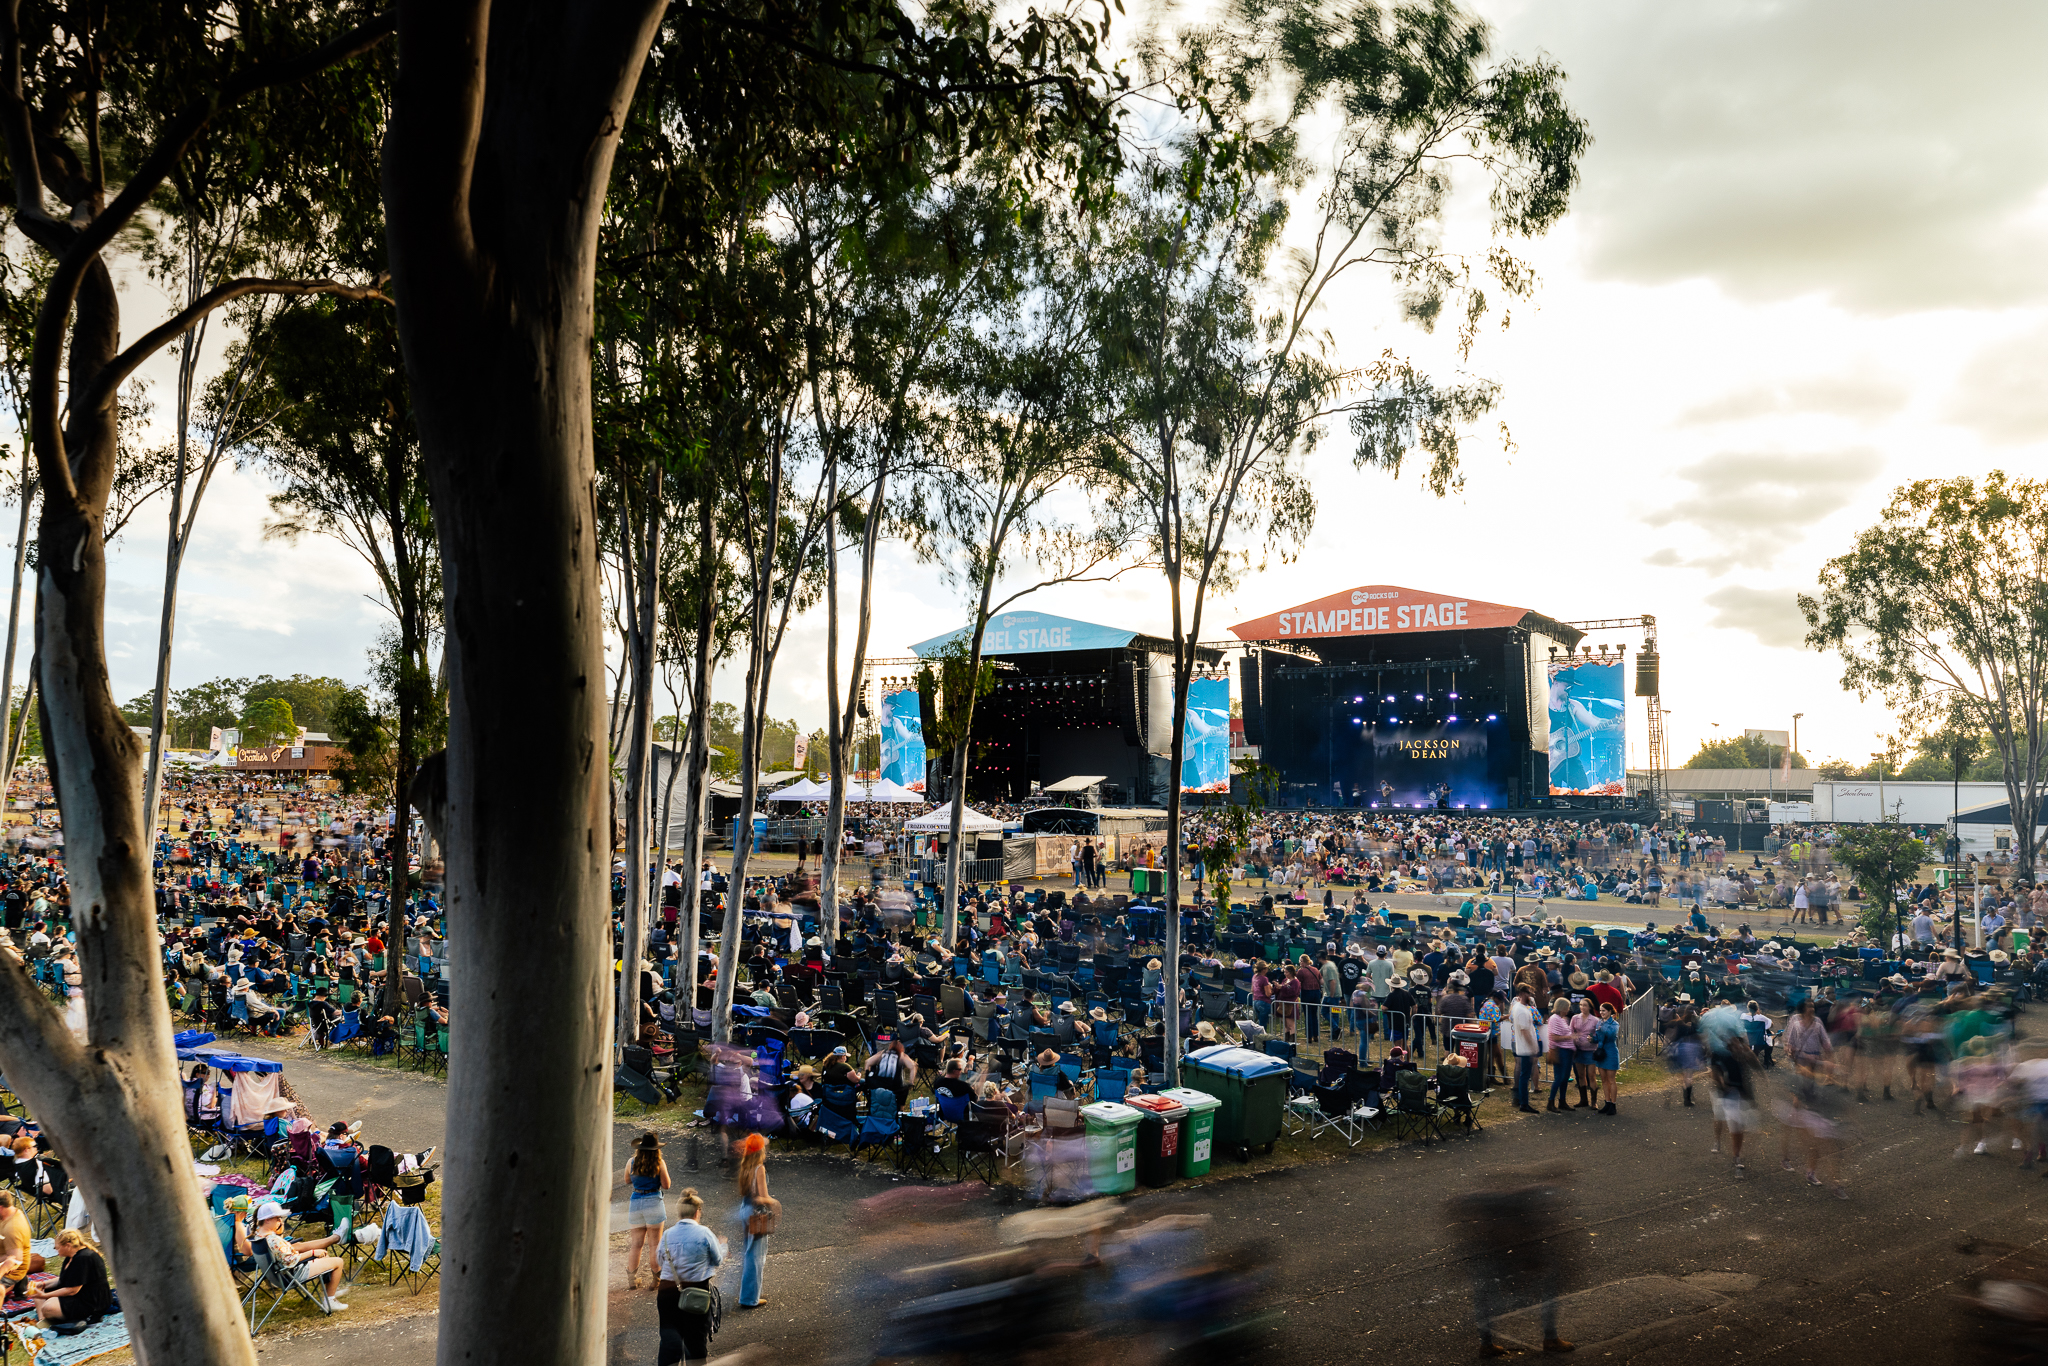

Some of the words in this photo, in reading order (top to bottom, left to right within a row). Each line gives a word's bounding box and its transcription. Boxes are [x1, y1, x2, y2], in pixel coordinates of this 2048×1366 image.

[1278, 606, 1390, 635] STAMPEDE
[1397, 602, 1469, 628] STAGE
[981, 630, 1013, 651] BEL
[1018, 626, 1072, 649] STAGE
[1399, 739, 1460, 751] JACKSON
[238, 749, 269, 762] Charlie's
[1411, 749, 1447, 759] DEAN
